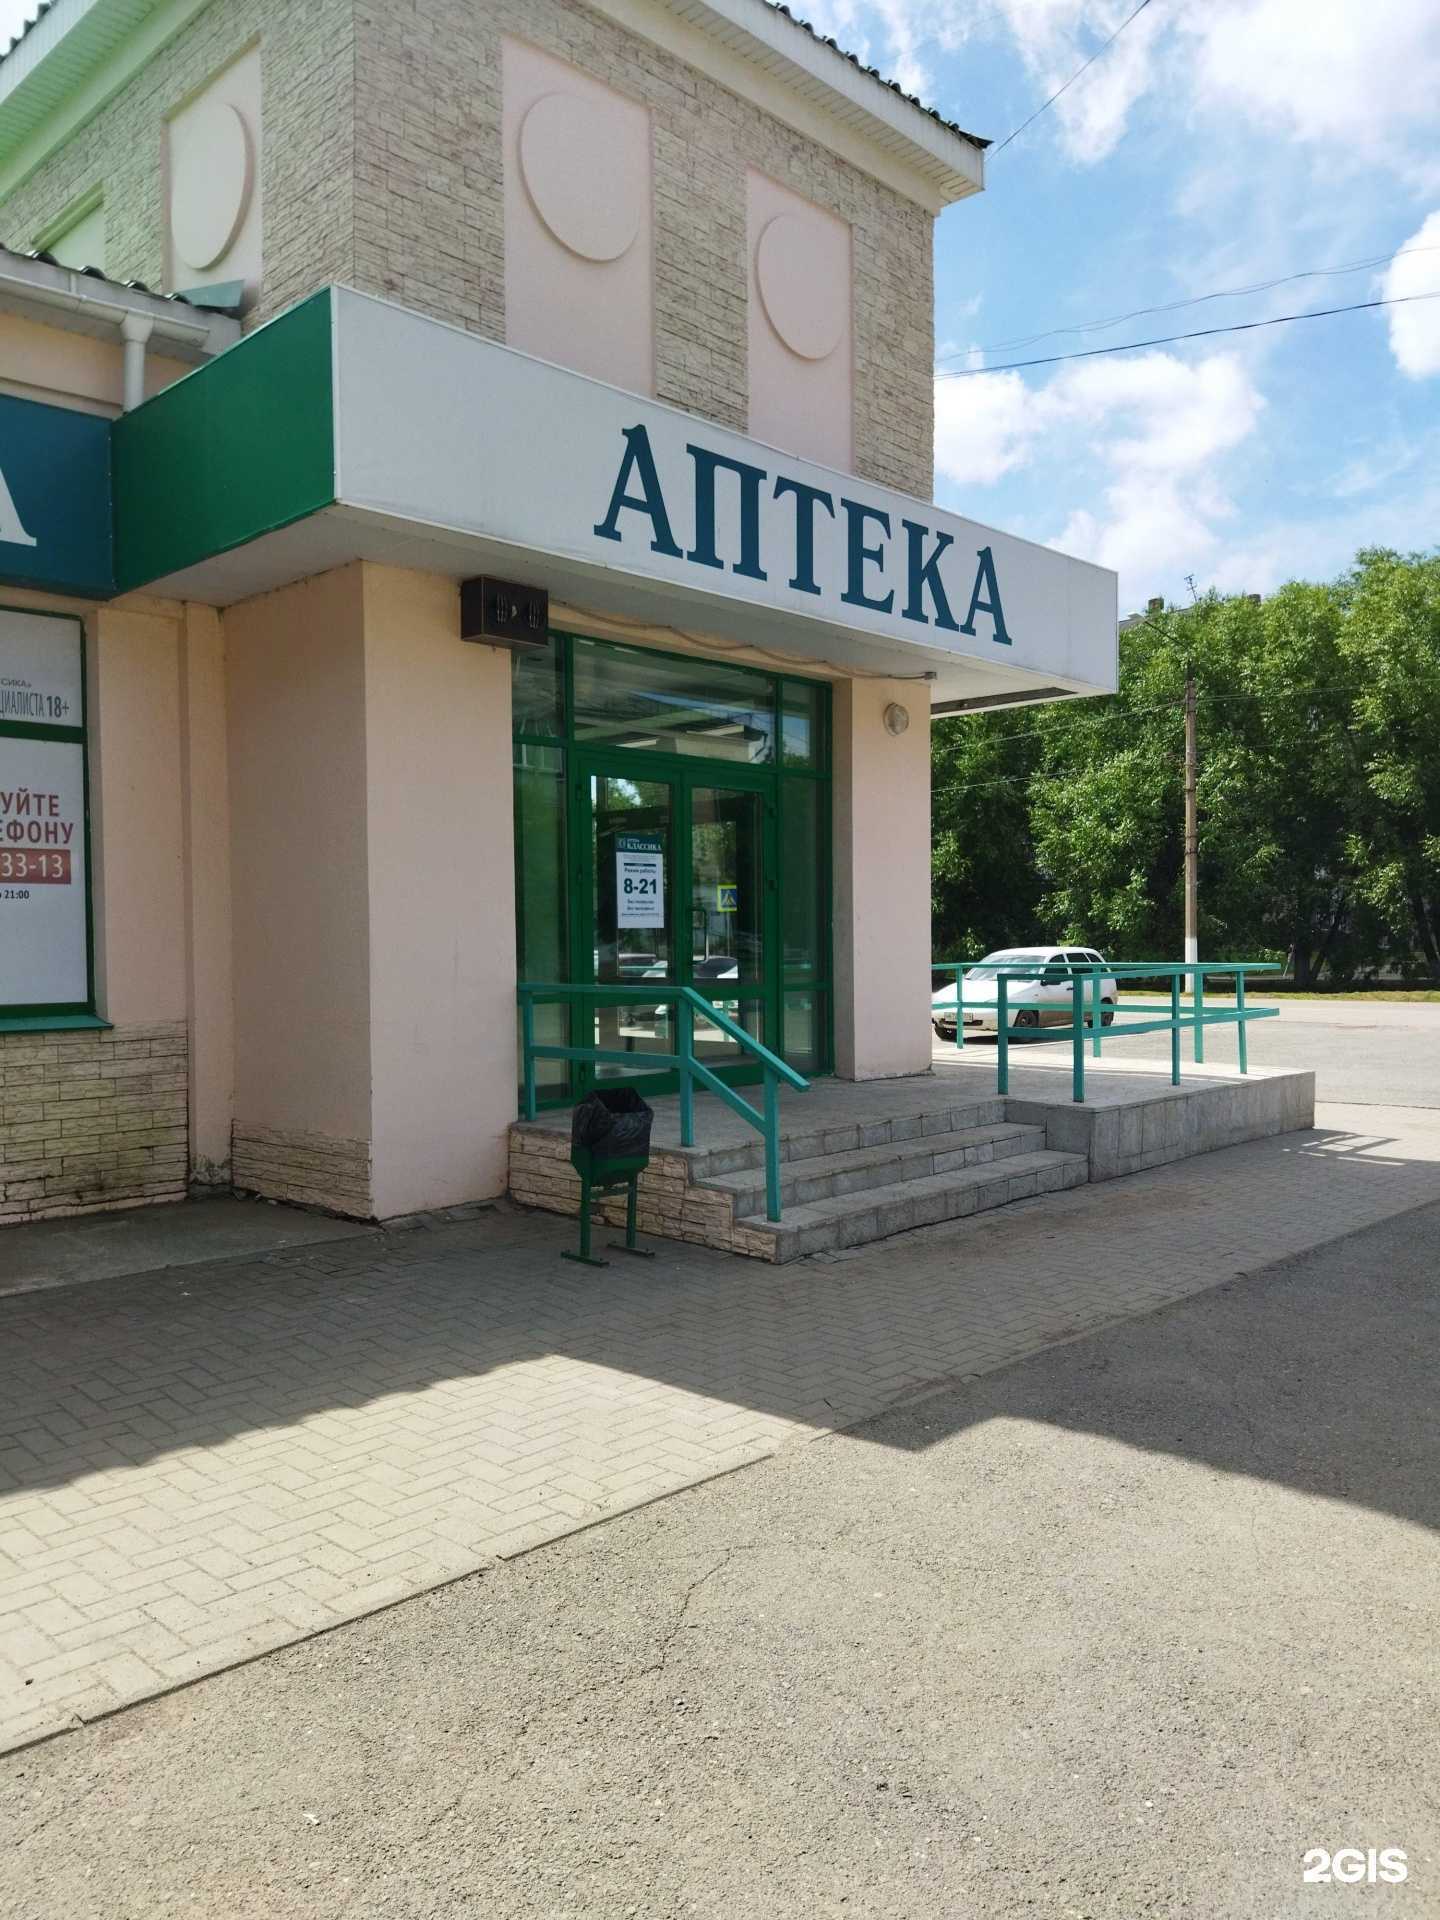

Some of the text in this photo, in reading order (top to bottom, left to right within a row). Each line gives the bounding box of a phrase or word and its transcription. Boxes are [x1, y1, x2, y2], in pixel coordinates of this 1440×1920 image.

[593, 424, 1013, 646] АПТЕКА
[46, 695, 70, 718] 18+
[0, 787, 60, 817] УЙТЕ
[1, 852, 63, 878] 33-13
[4, 890, 30, 899] 21:00
[623, 878, 657, 894] 8-21
